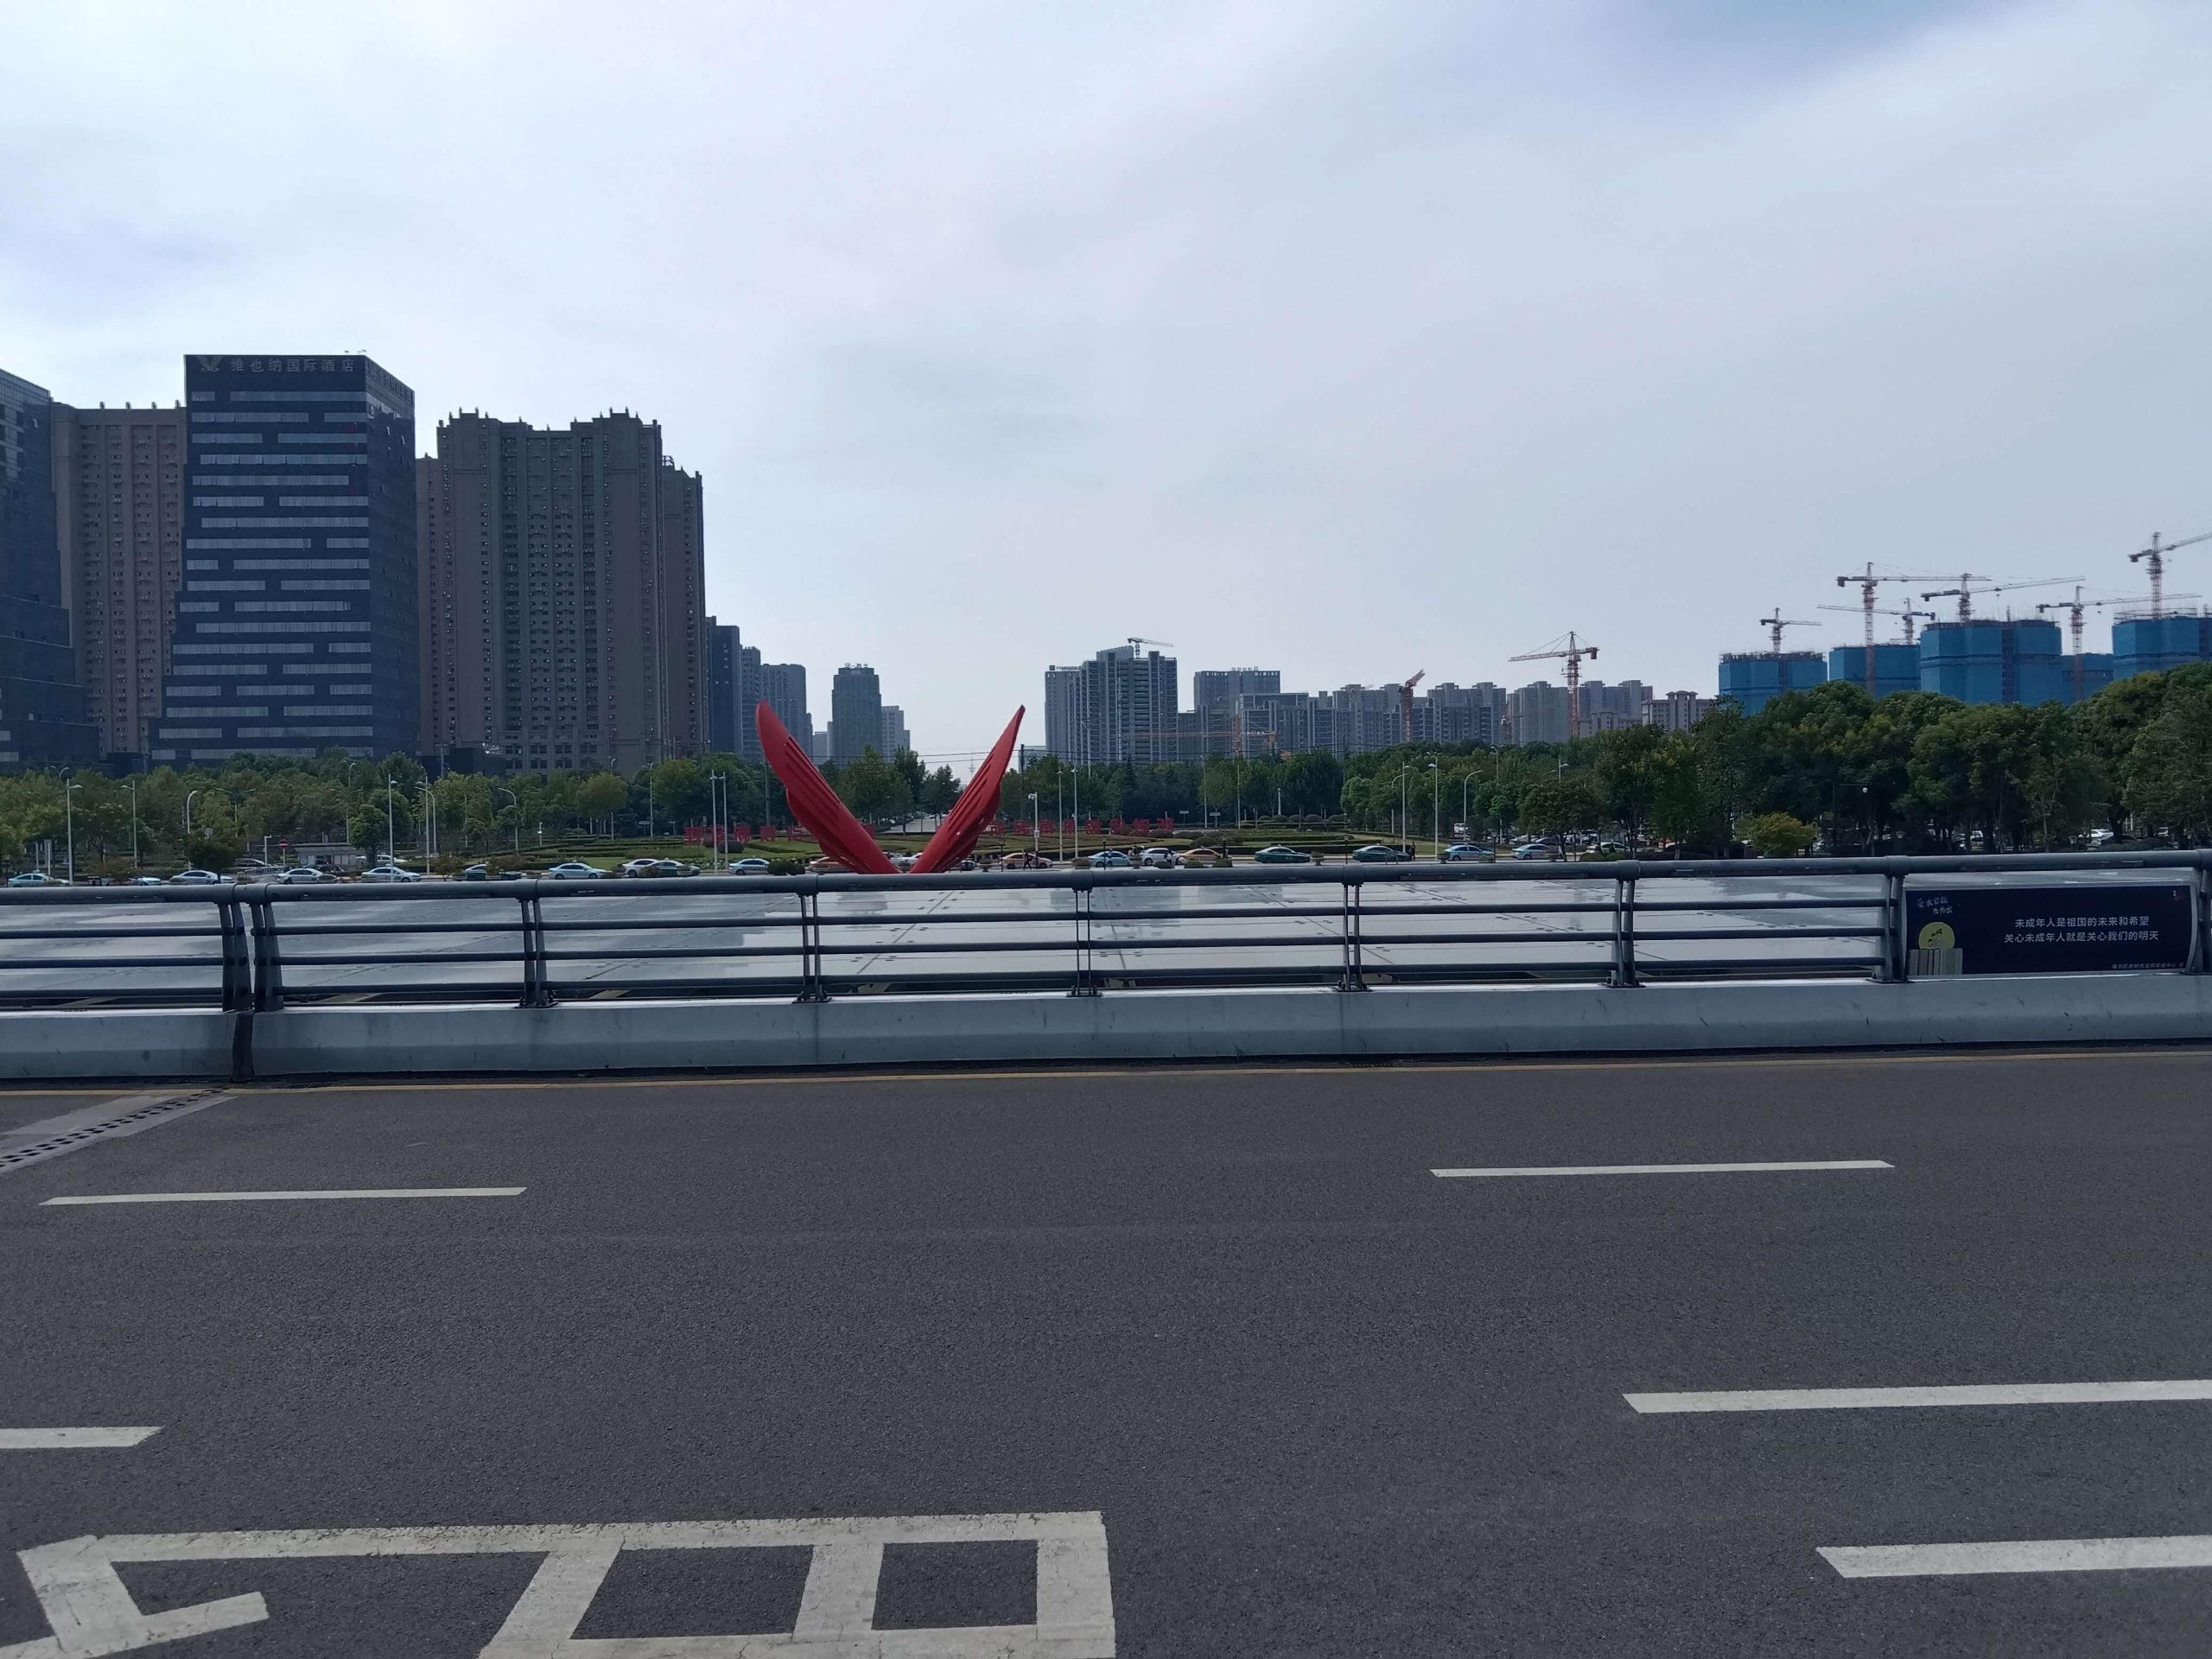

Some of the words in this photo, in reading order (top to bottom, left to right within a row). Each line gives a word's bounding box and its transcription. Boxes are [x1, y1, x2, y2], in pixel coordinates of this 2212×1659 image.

[230, 358, 354, 372] 维也纳国际酒店
[2015, 916, 2149, 928] 未成年人是祖国的未来和希望
[2005, 931, 2159, 944] 关心未成年人就是关心我们的明天
